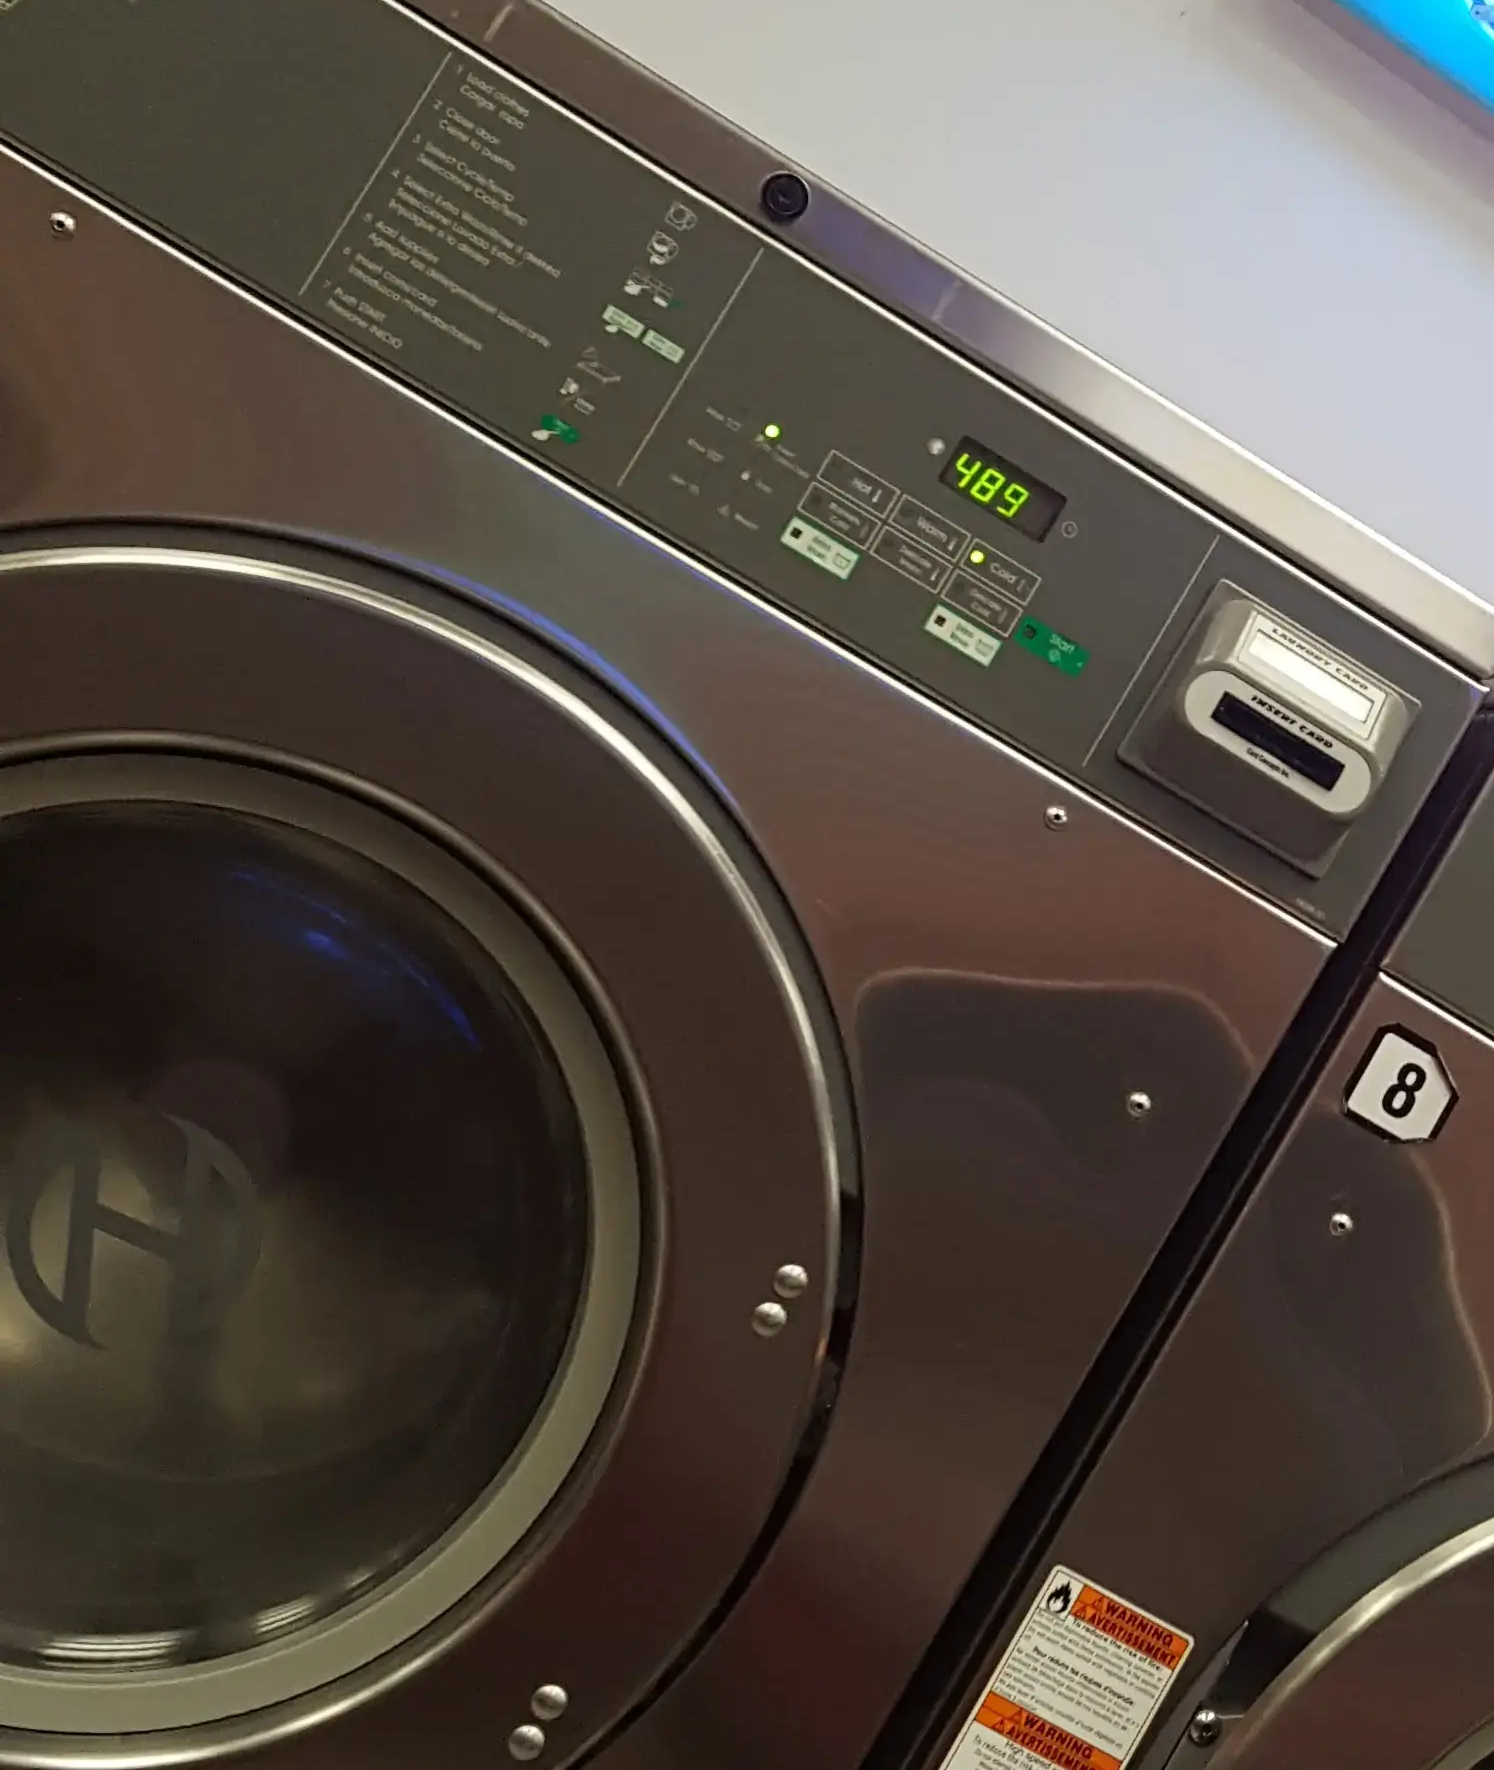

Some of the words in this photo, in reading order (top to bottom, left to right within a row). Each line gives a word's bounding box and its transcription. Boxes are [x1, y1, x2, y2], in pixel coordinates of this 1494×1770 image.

[954, 452, 1029, 519] 489
[1335, 666, 1368, 691] CARD
[1251, 695, 1300, 725] INSERT
[1299, 724, 1334, 750] CARD
[1382, 1062, 1426, 1118] 8
[1087, 1611, 1177, 1666] AVERTISSEMENT
[1103, 1601, 1175, 1646] WARNING
[1022, 1714, 1094, 1759] WARNING
